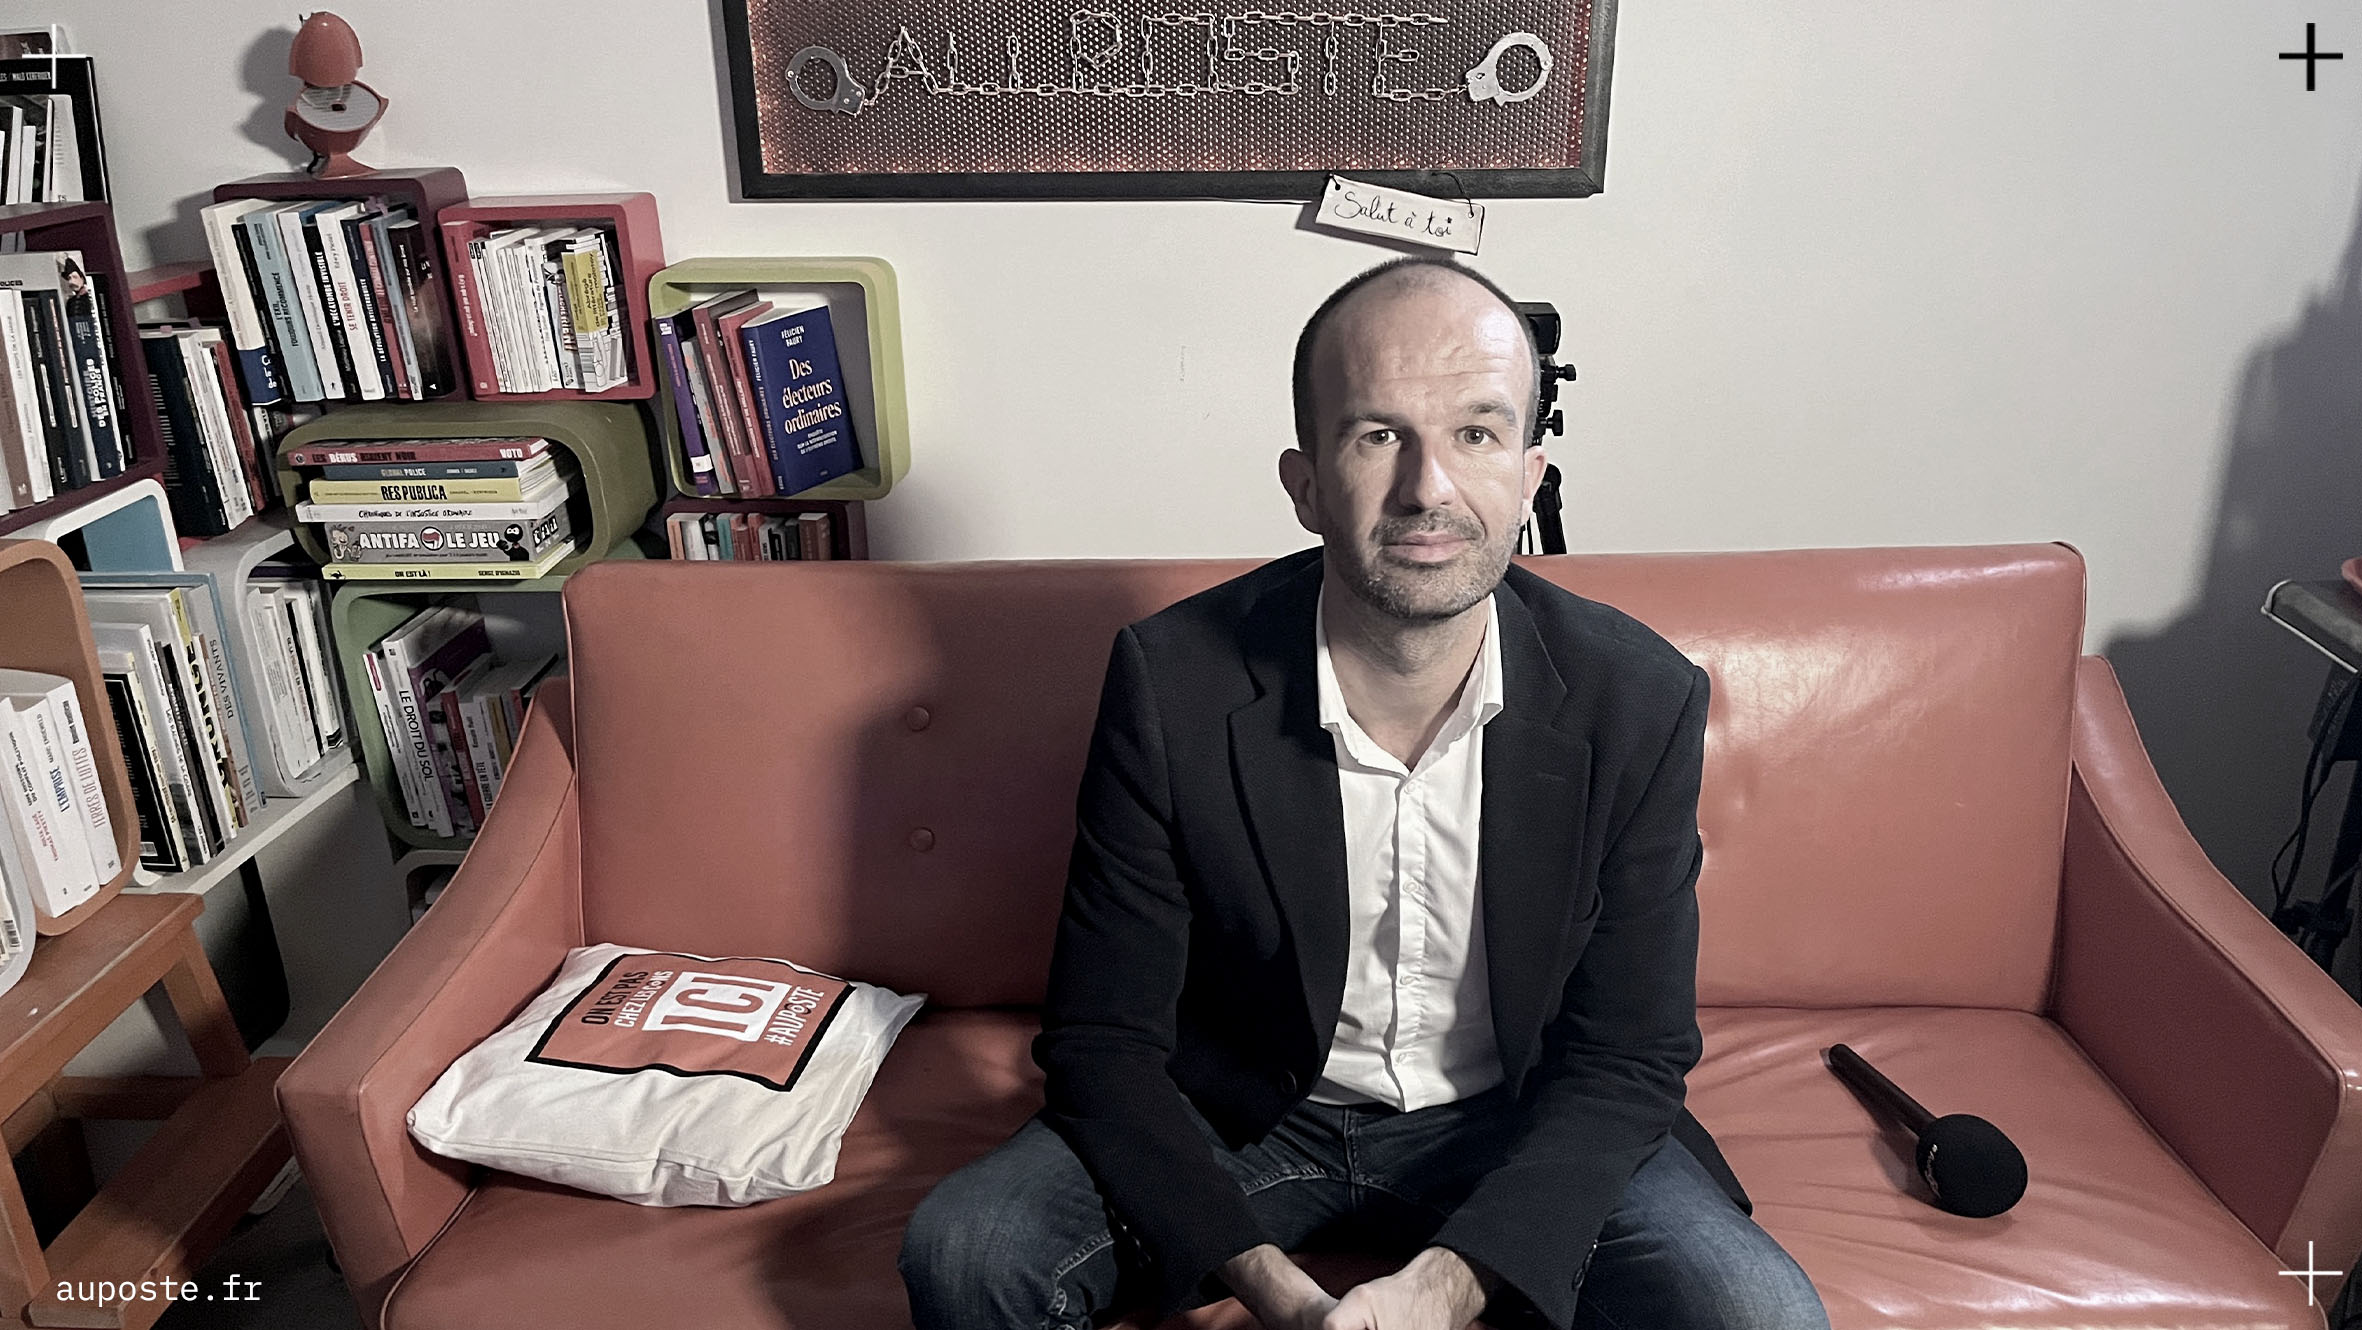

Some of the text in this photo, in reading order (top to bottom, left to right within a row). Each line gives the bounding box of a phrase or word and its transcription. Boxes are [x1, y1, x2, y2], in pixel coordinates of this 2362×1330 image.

[1334, 191, 1453, 238] Salut à toi
[315, 250, 328, 282] INVISIBLE
[337, 282, 349, 301] DROIT
[582, 278, 591, 308] Abrégé
[587, 273, 599, 326] de littérature
[343, 302, 354, 321] TENIR
[348, 322, 357, 331] SE
[780, 324, 804, 339] FÉLICIEN
[786, 335, 803, 348] FAURY
[748, 340, 756, 356] FAURY
[752, 357, 761, 381] FÉLICIEN
[788, 358, 813, 380] Des
[86, 359, 106, 426] DES POLICES
[93, 368, 105, 402] FRANCE
[782, 378, 833, 409] électeurs
[784, 401, 842, 435] ordinaires
[312, 454, 327, 463] LES
[328, 452, 358, 463] BÉRUS
[404, 468, 426, 476] POLICE
[380, 486, 400, 500] RES
[402, 485, 448, 500] PUBLICA
[359, 532, 500, 549] ANTIFA LE JEU
[209, 639, 233, 718] DES VIVANTS
[9, 731, 23, 766] POLITIQUE
[398, 689, 433, 780] LE DROIT DU SOL
[15, 763, 27, 792] HISTOIRE
[21, 766, 33, 791] CONFLIT
[475, 761, 485, 773] TÊTE
[50, 767, 69, 811] L'EMPRISE
[72, 747, 105, 827] TERRES DE LUTTES
[581, 971, 649, 1024] ON EST PAS
[614, 970, 674, 1028] CHEZ LES CONS
[660, 976, 775, 1033] ICI
[764, 986, 824, 1046] #AUPOSTE
